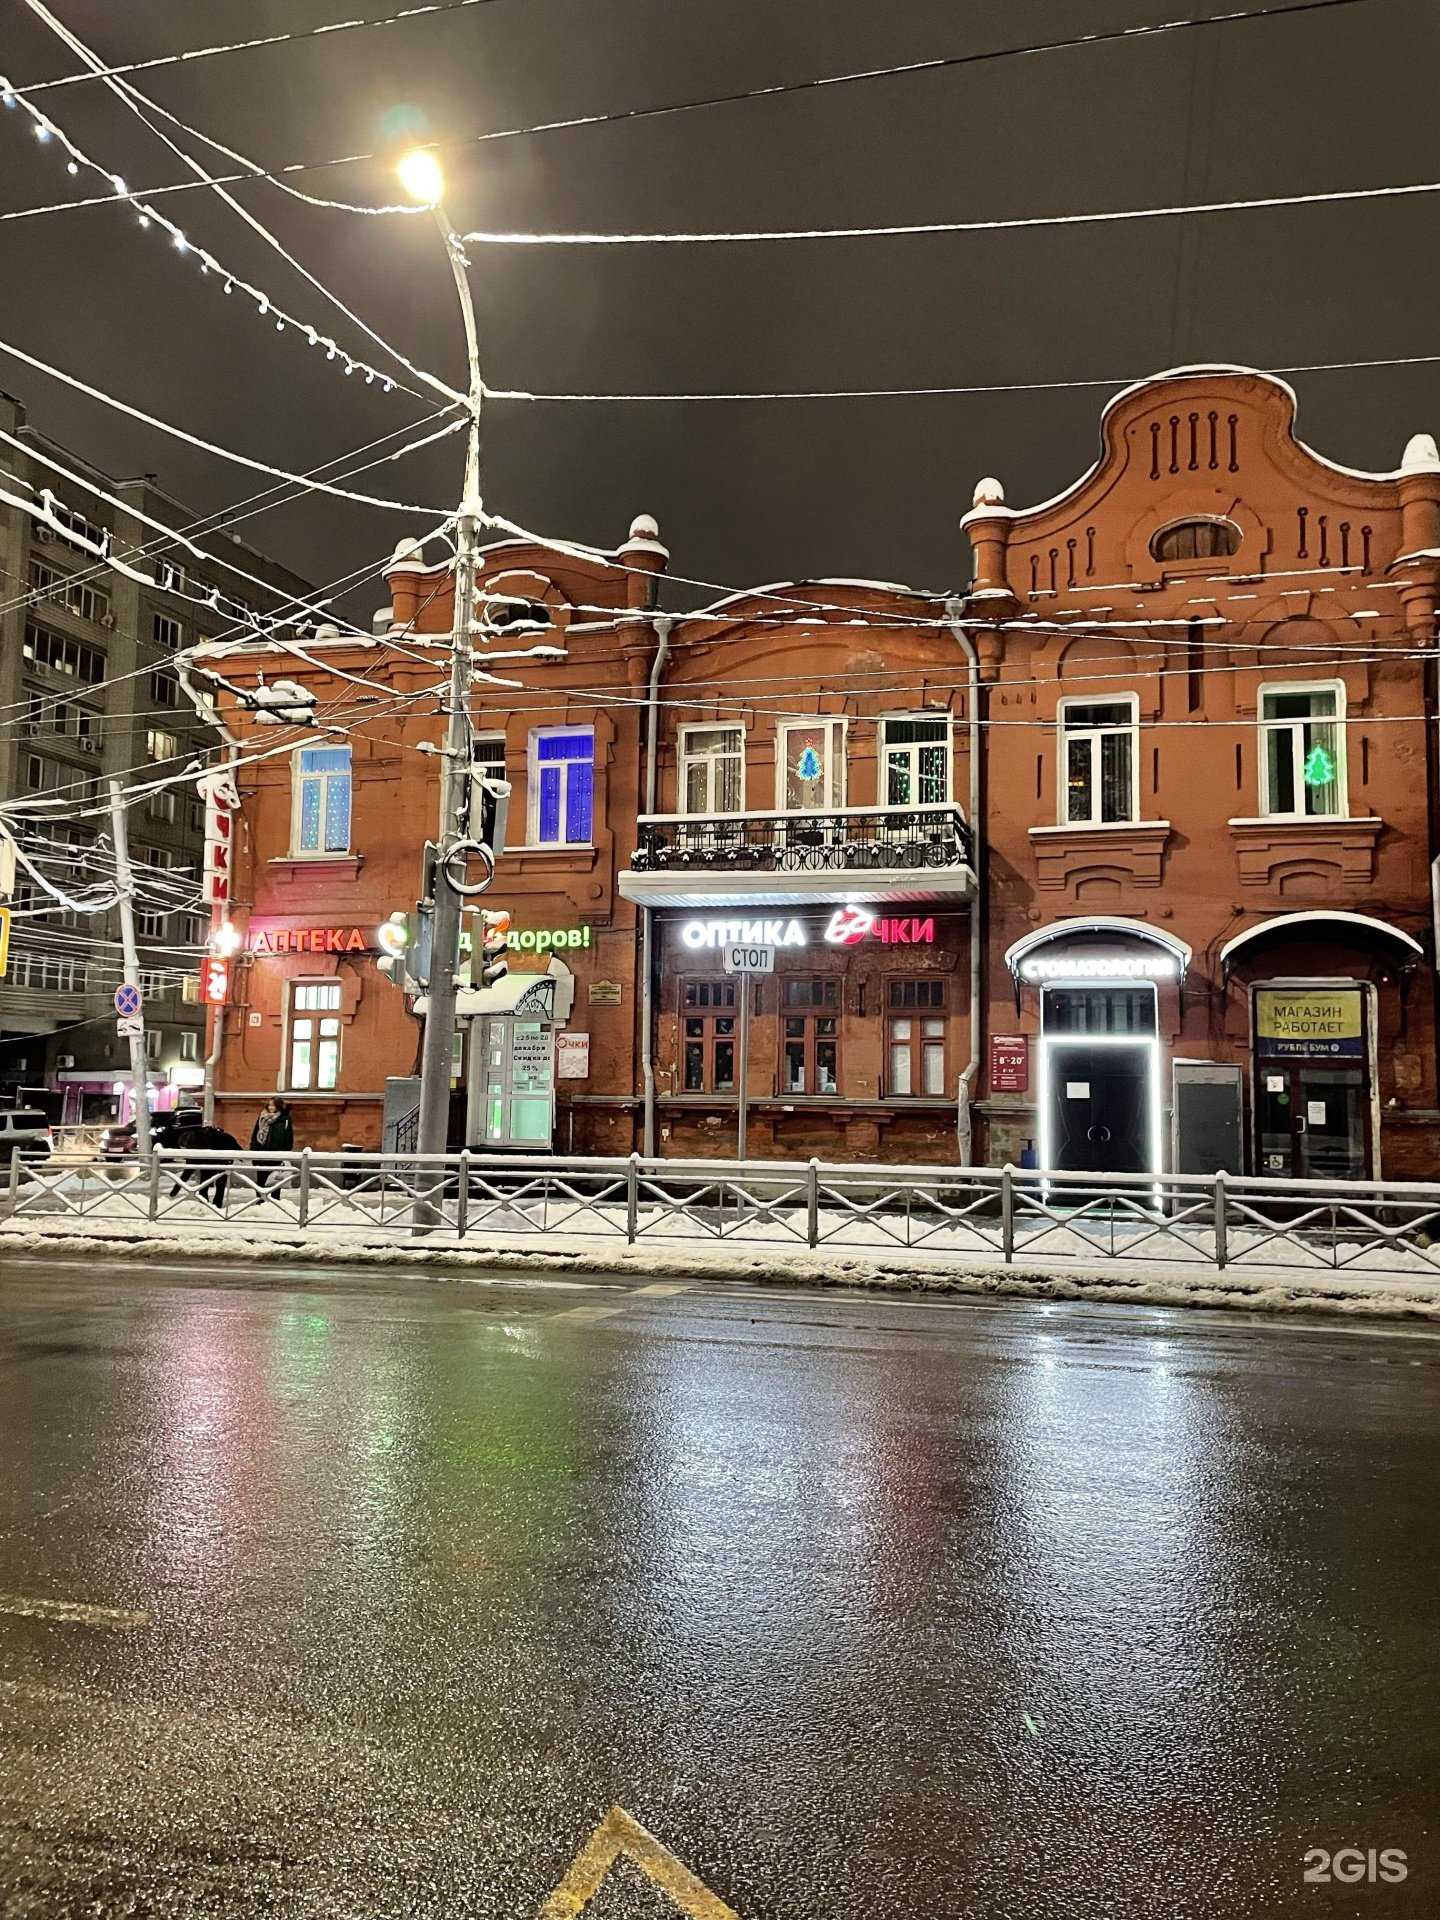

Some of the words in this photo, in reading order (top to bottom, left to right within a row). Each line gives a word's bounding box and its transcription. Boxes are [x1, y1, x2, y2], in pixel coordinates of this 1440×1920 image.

[252, 928, 365, 952] АПТЕКА
[506, 925, 590, 953] доров!
[682, 919, 807, 948] ОПТИКА
[732, 948, 768, 968] СТОП
[1273, 1006, 1342, 1018] МАГАЗИН
[1273, 1022, 1345, 1033] РАБОТАЕТ
[1309, 1043, 1330, 1052] БУМ
